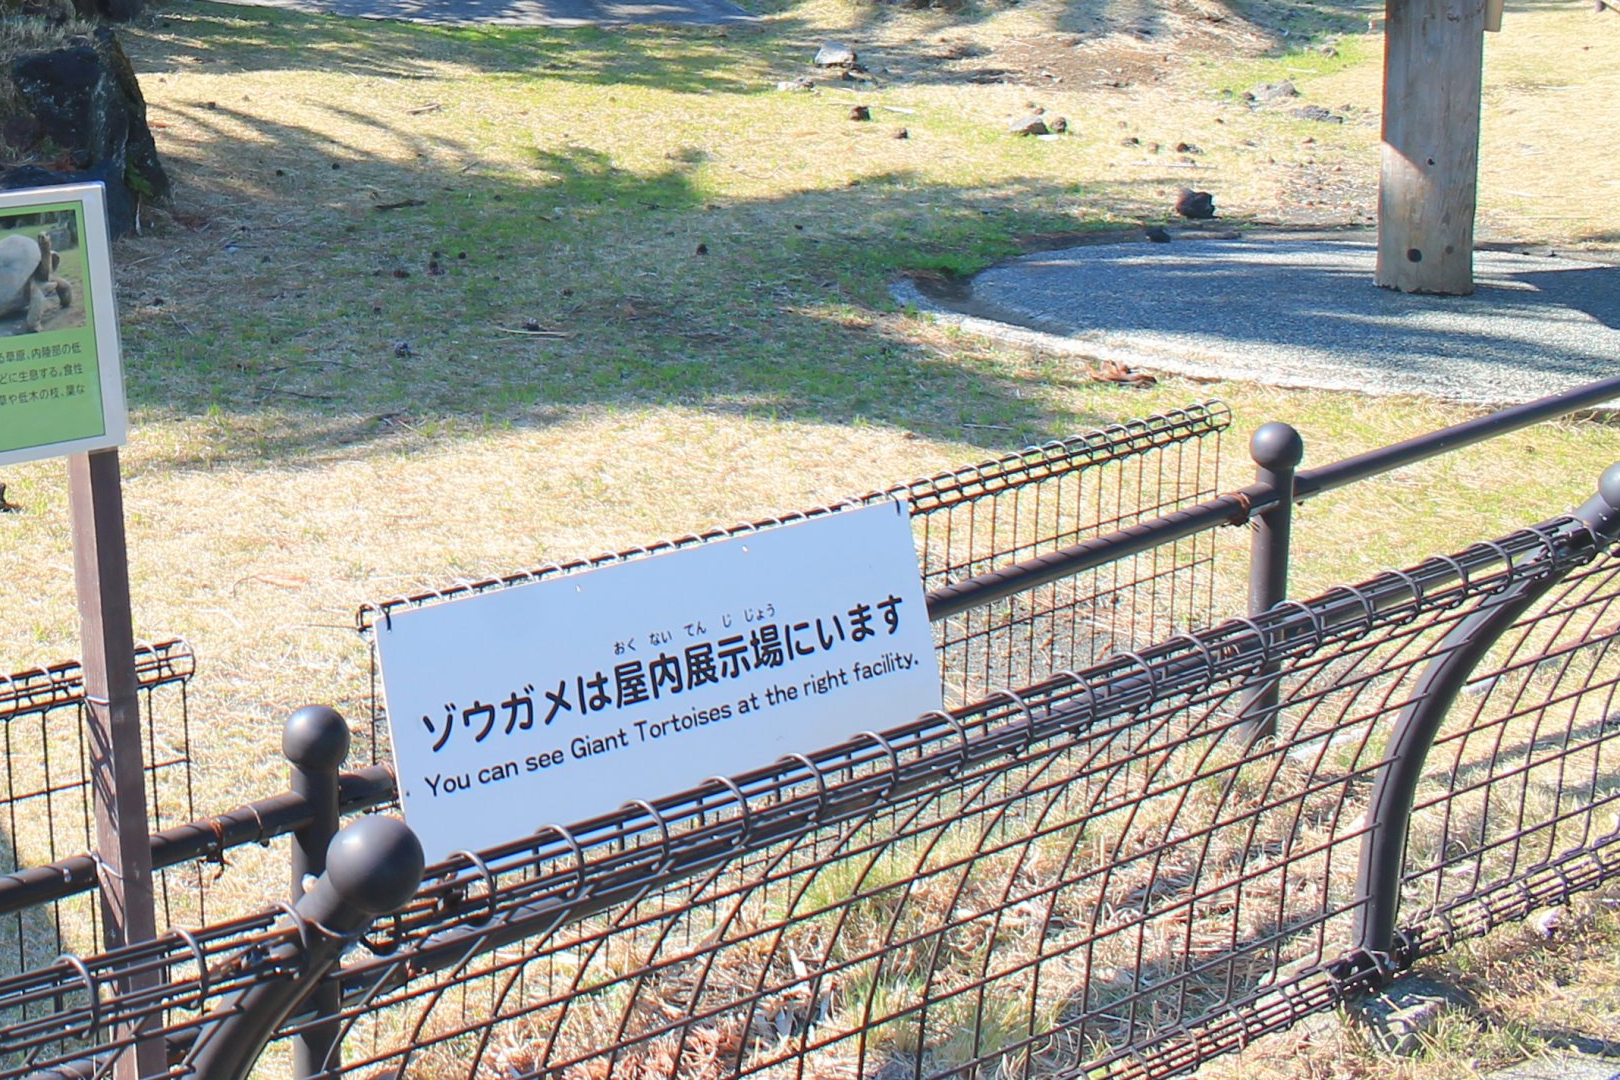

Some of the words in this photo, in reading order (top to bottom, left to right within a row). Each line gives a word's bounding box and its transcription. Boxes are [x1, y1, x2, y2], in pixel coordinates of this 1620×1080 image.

[422, 594, 903, 753] ゾウガメは屋内展示場にいます
[614, 638, 637, 655] おく
[648, 630, 673, 646] ない
[684, 621, 707, 638] てん
[722, 613, 733, 628] じ
[744, 603, 776, 623] じょう
[424, 773, 471, 797] You
[478, 760, 519, 784] can
[525, 749, 565, 772] see
[570, 729, 629, 759] Giant
[633, 703, 732, 742] Tortoises
[737, 693, 761, 715] at
[765, 683, 798, 707] the
[803, 669, 849, 697] right
[852, 652, 920, 682] facility.
